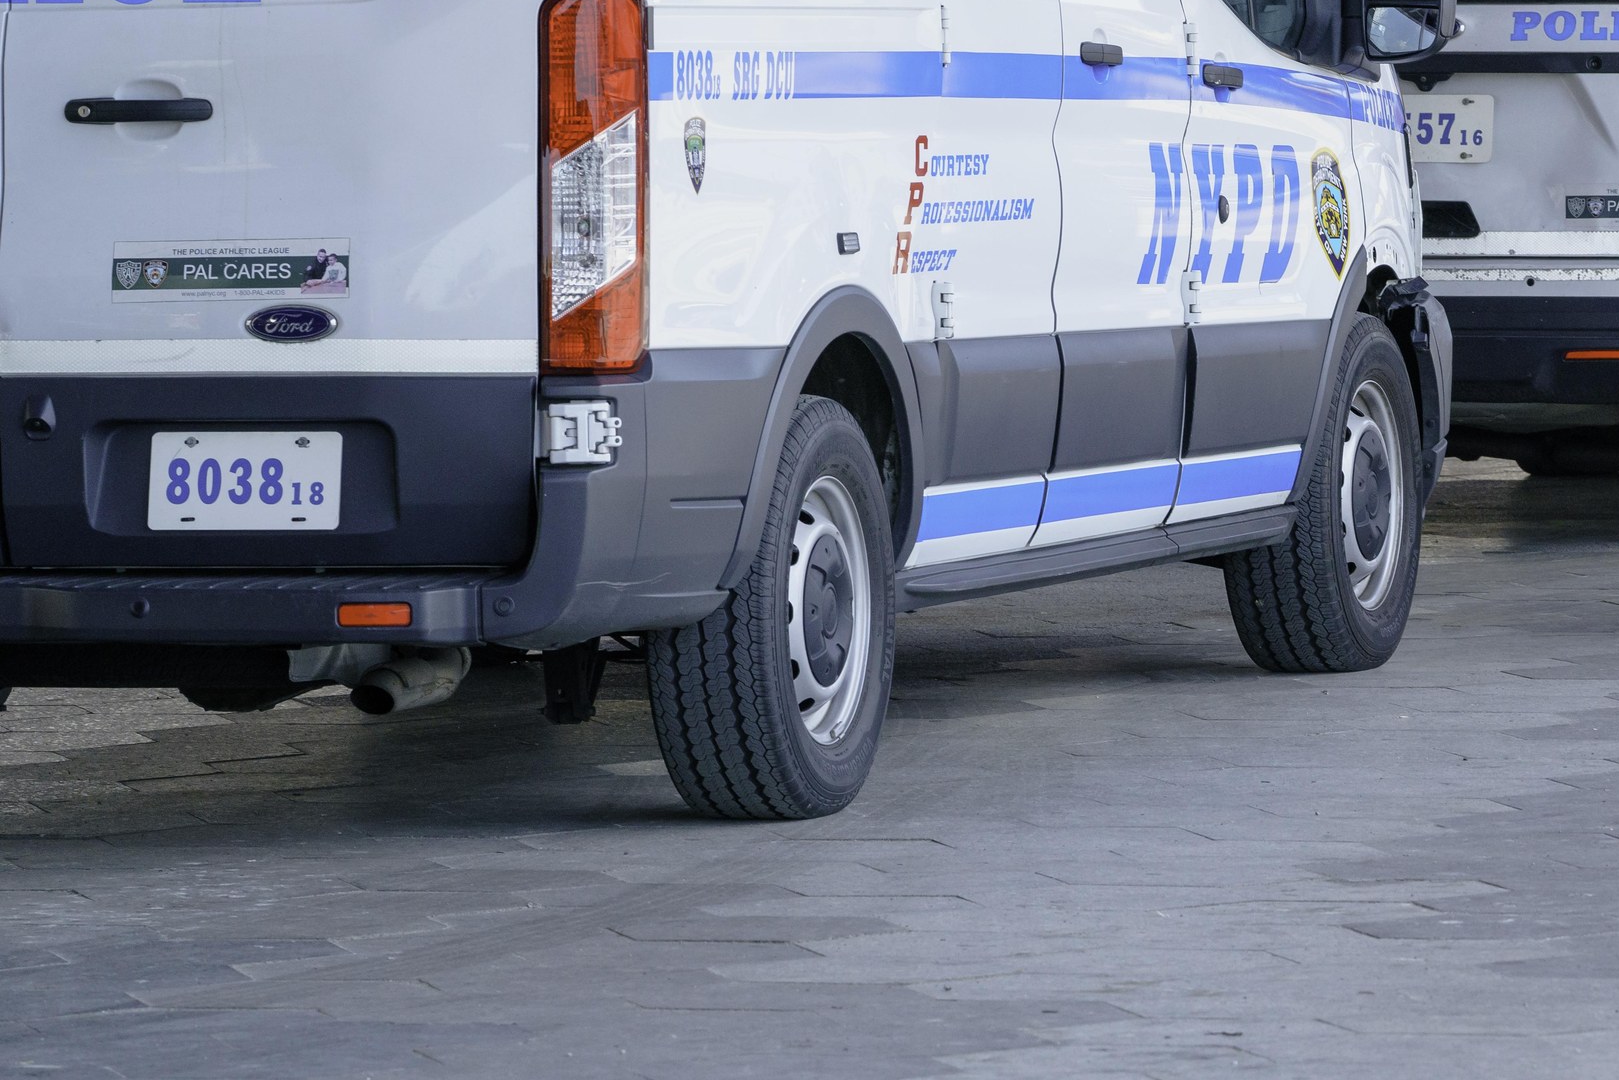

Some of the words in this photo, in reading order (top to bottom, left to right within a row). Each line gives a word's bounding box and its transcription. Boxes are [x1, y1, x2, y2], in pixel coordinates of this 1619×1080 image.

[676, 50, 713, 100] 8038
[732, 50, 760, 101] SRG
[764, 50, 794, 100] DCU
[1407, 113, 1455, 145] 57
[1136, 142, 1300, 284] NYPD
[172, 248, 188, 256] THE
[218, 247, 256, 255] ATHLETIC
[258, 247, 290, 255] LEAGUE
[183, 263, 218, 280] PAL
[223, 263, 291, 280] CARES
[264, 312, 314, 334] Ford
